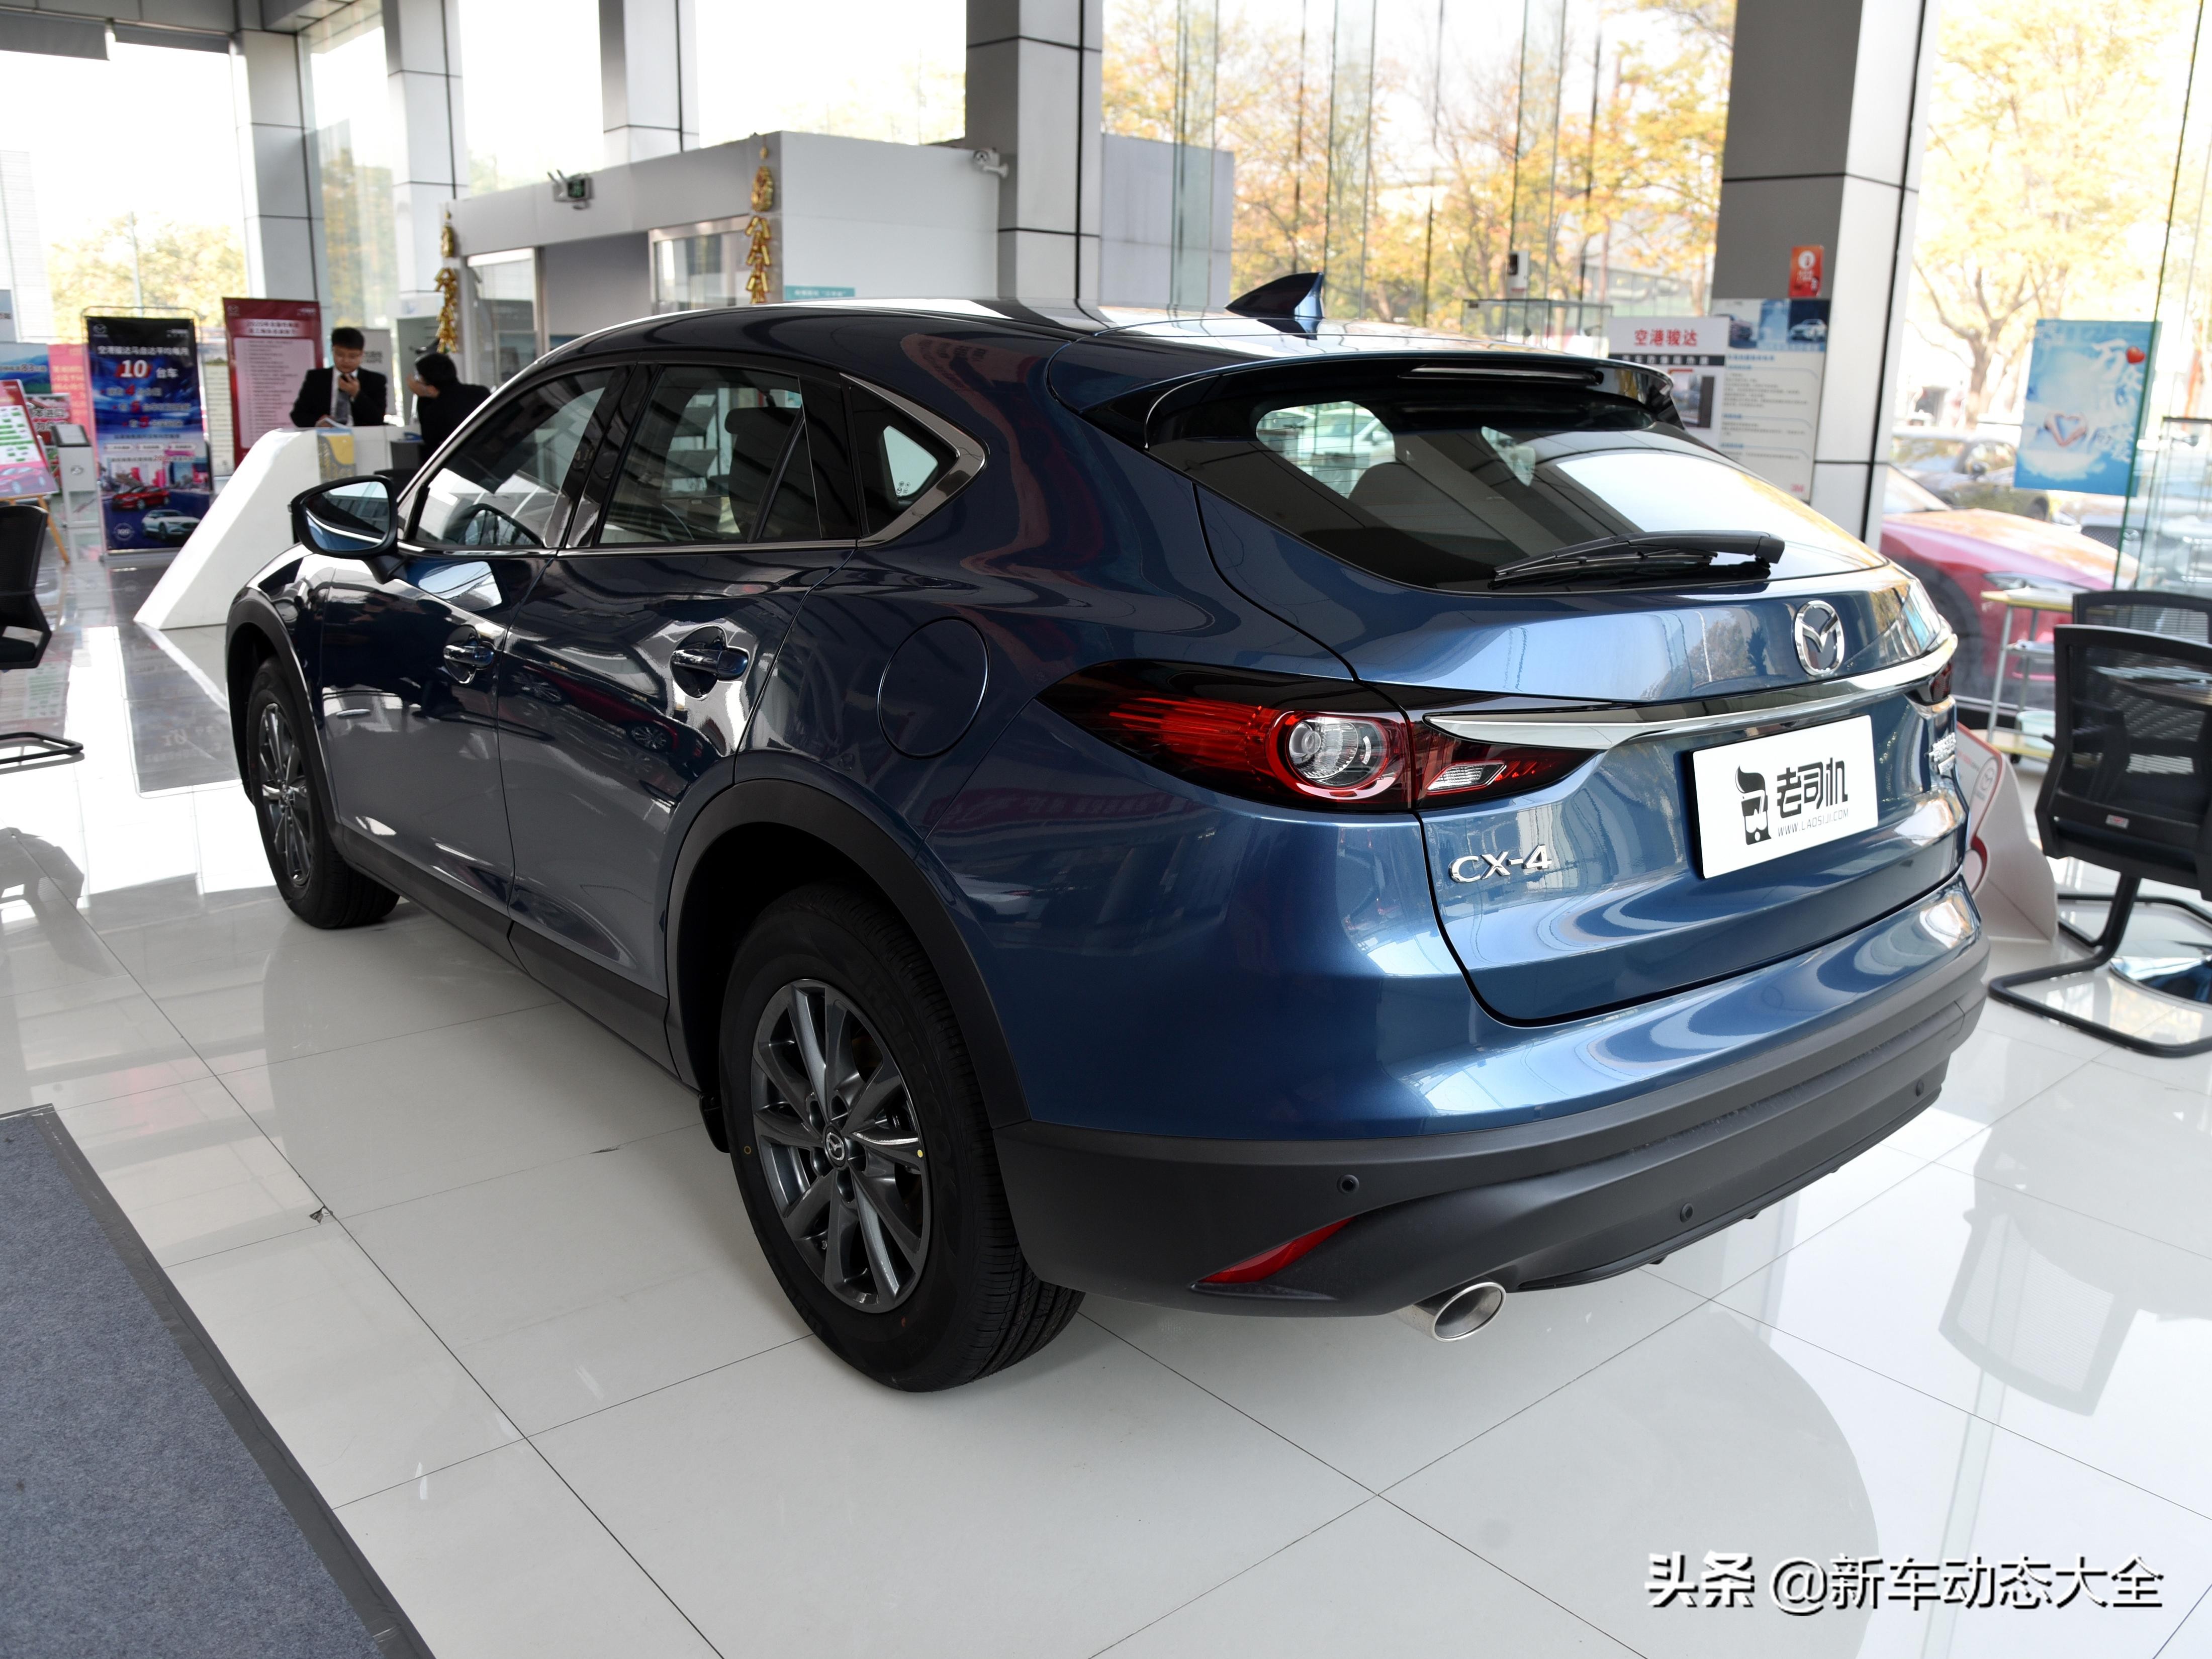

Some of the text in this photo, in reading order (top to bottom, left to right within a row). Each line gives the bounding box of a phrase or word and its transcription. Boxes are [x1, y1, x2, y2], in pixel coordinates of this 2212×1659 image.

[1634, 329, 1697, 346] 空港骏达
[120, 359, 148, 378] 10
[1777, 757, 1848, 818] 老司机
[1778, 808, 1849, 837] WWW.LAOSIJI.COM
[1448, 844, 1552, 883] CX-4
